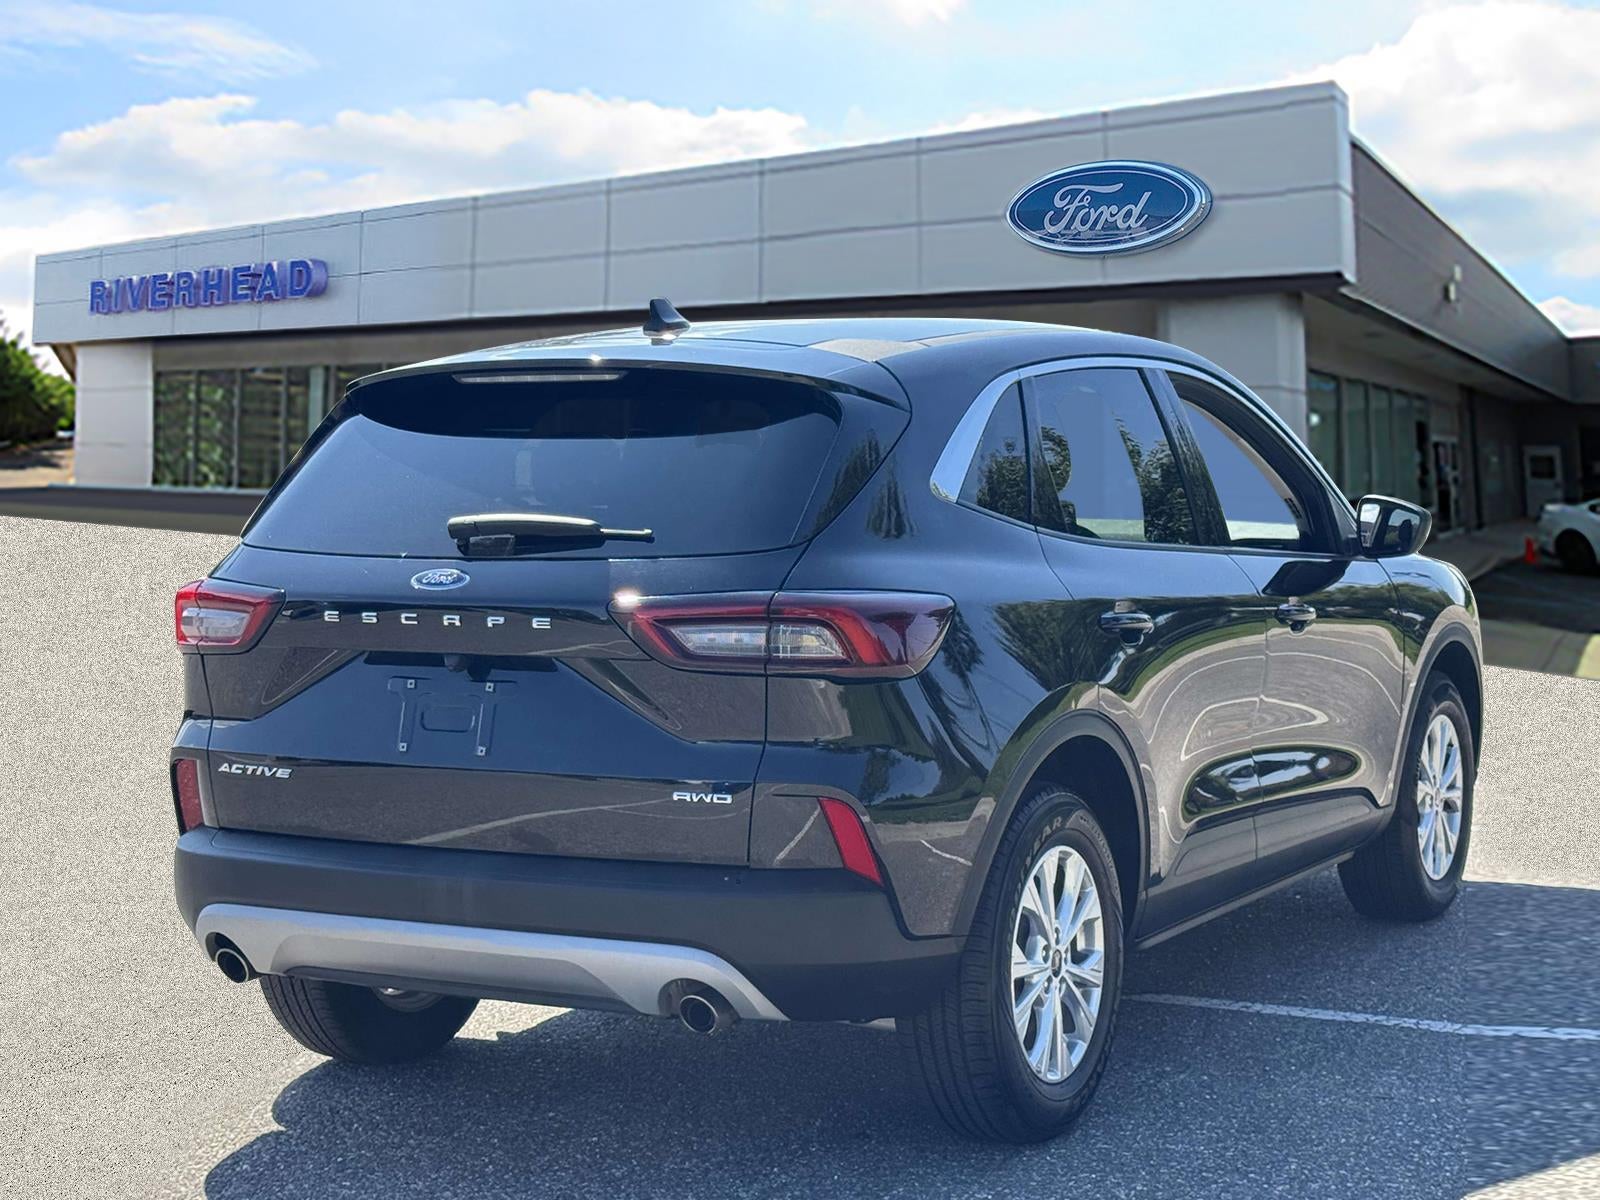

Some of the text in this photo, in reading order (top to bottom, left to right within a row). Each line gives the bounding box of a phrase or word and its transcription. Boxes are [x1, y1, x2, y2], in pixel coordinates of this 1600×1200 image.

[1043, 182, 1152, 234] Ford
[89, 258, 327, 315] RIVERHEAD
[323, 610, 552, 629] ESCAPE
[217, 762, 292, 779] ACTIVE
[672, 791, 733, 804] AWD
